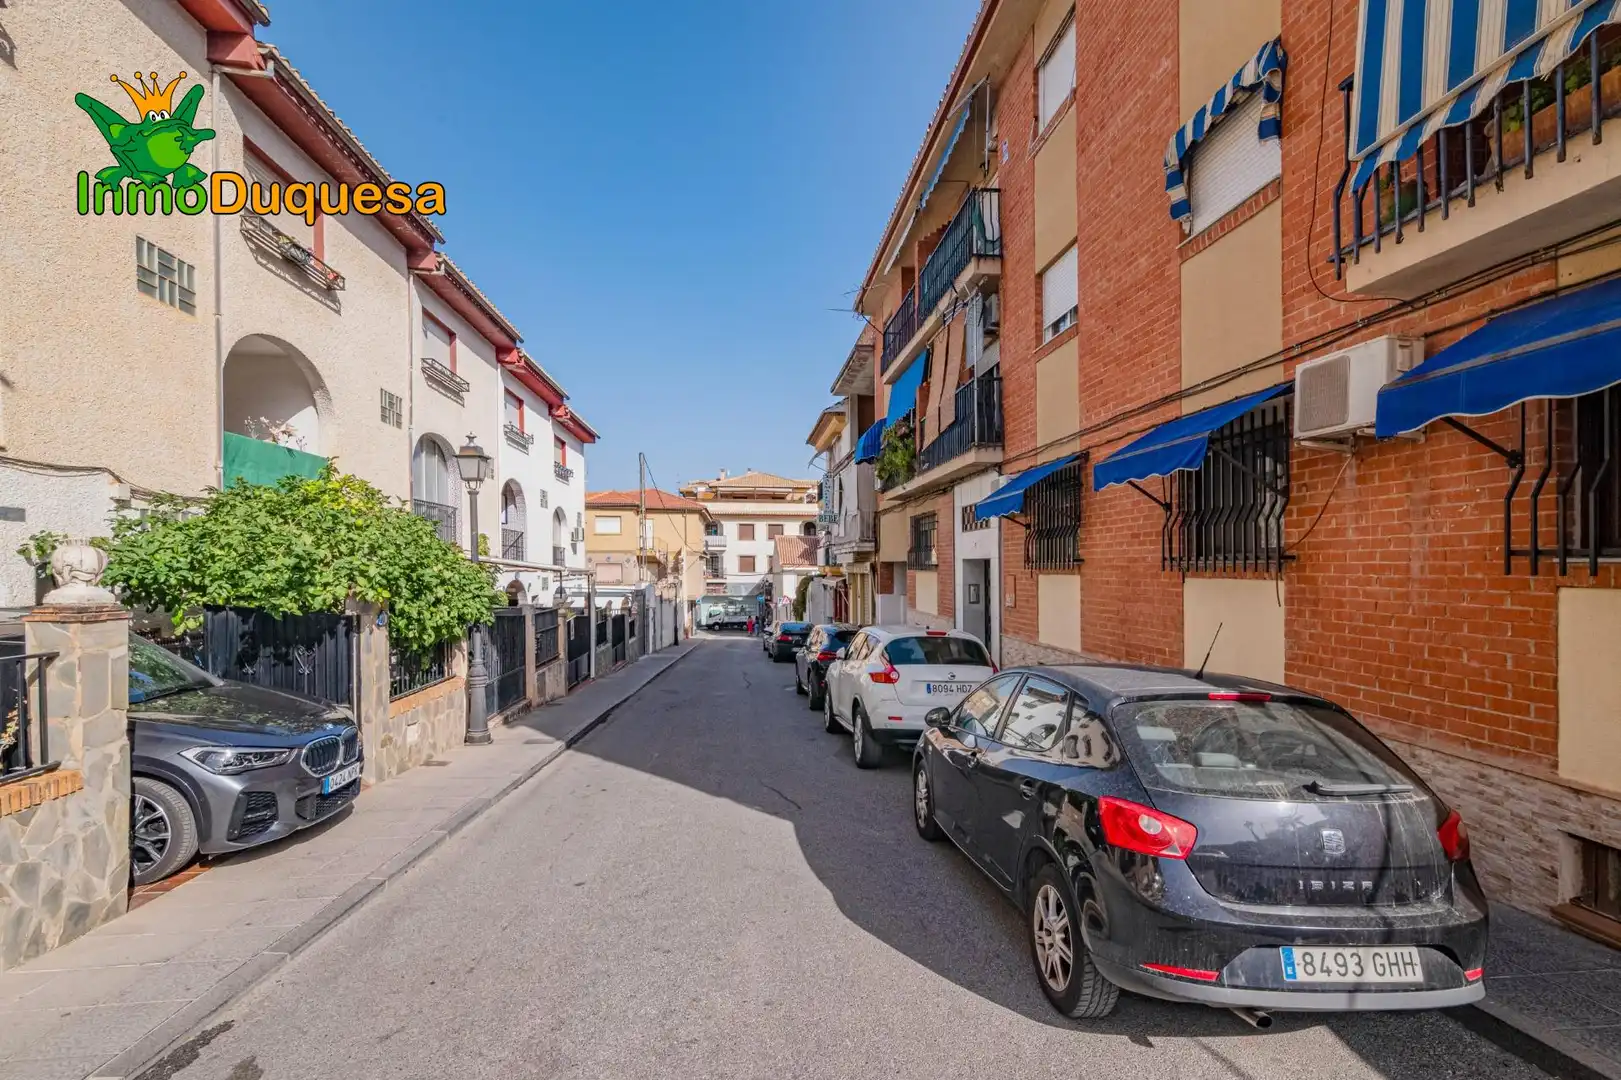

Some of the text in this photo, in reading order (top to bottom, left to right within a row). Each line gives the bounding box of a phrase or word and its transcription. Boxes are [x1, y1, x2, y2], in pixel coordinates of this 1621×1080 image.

[932, 684, 954, 693] 8094
[1302, 951, 1365, 977] 8493
[1372, 951, 1417, 977] GHH
